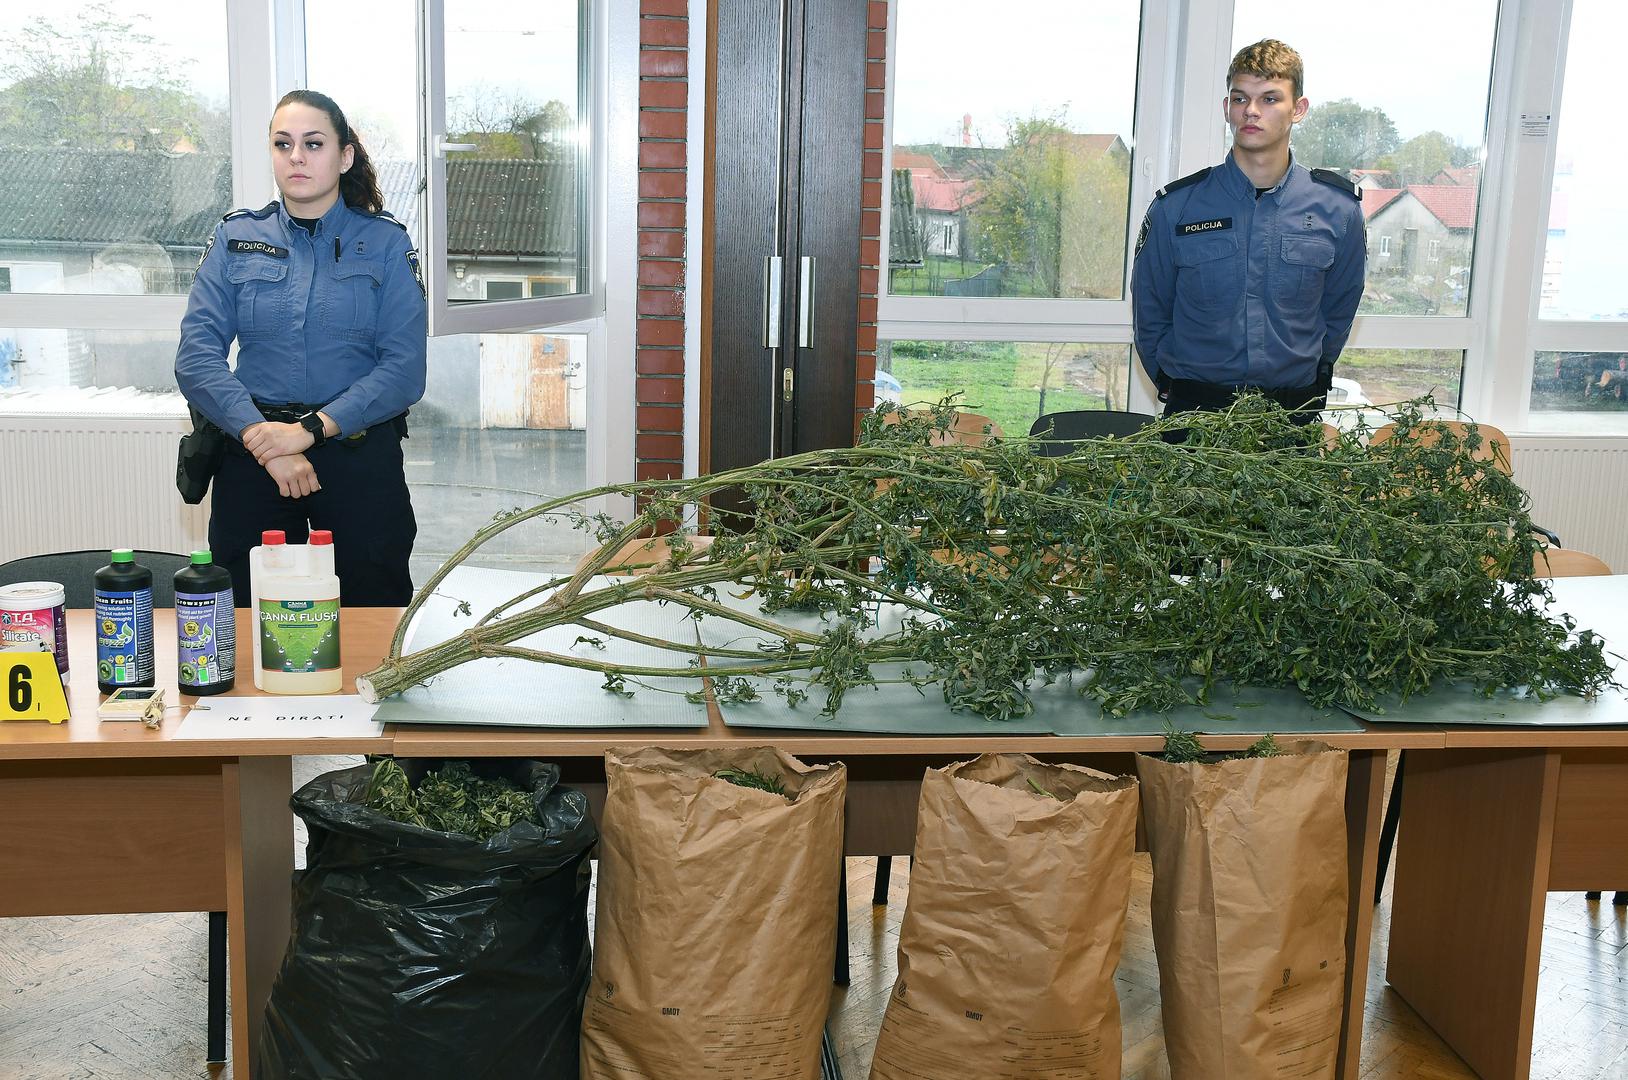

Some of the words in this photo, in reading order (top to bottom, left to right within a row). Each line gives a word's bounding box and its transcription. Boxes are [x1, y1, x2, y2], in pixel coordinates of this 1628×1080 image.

[1185, 221, 1222, 232] POLICIJA
[237, 242, 277, 254] POLICIJA
[177, 598, 215, 607] Growzyme
[11, 612, 37, 623] T.A.
[260, 611, 297, 622] CANNA
[300, 611, 338, 622] FLUSH
[2, 629, 40, 642] Silicate
[99, 637, 125, 648] BUZZ
[9, 664, 33, 712] 6
